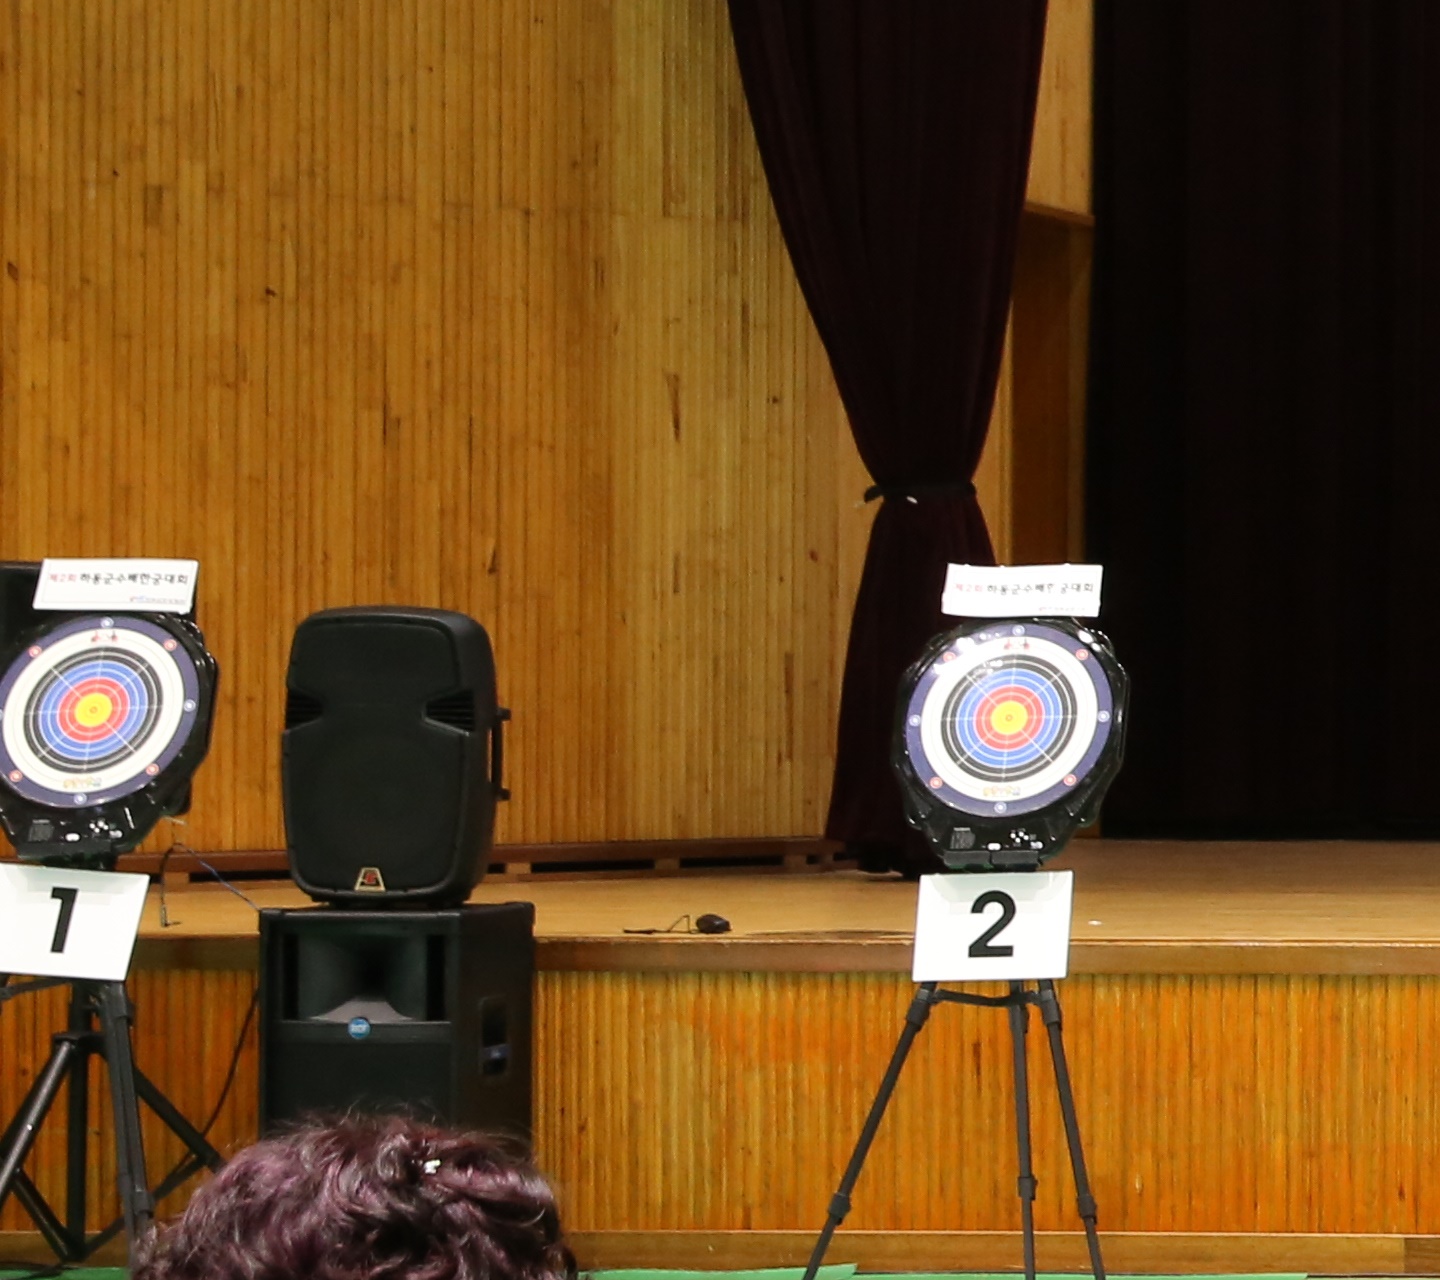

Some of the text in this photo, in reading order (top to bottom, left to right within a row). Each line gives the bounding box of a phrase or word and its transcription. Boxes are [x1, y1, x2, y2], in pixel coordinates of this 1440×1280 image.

[80, 572, 188, 586] 하동군수배한궁대회
[50, 886, 80, 954] 1
[968, 890, 1017, 958] 2
